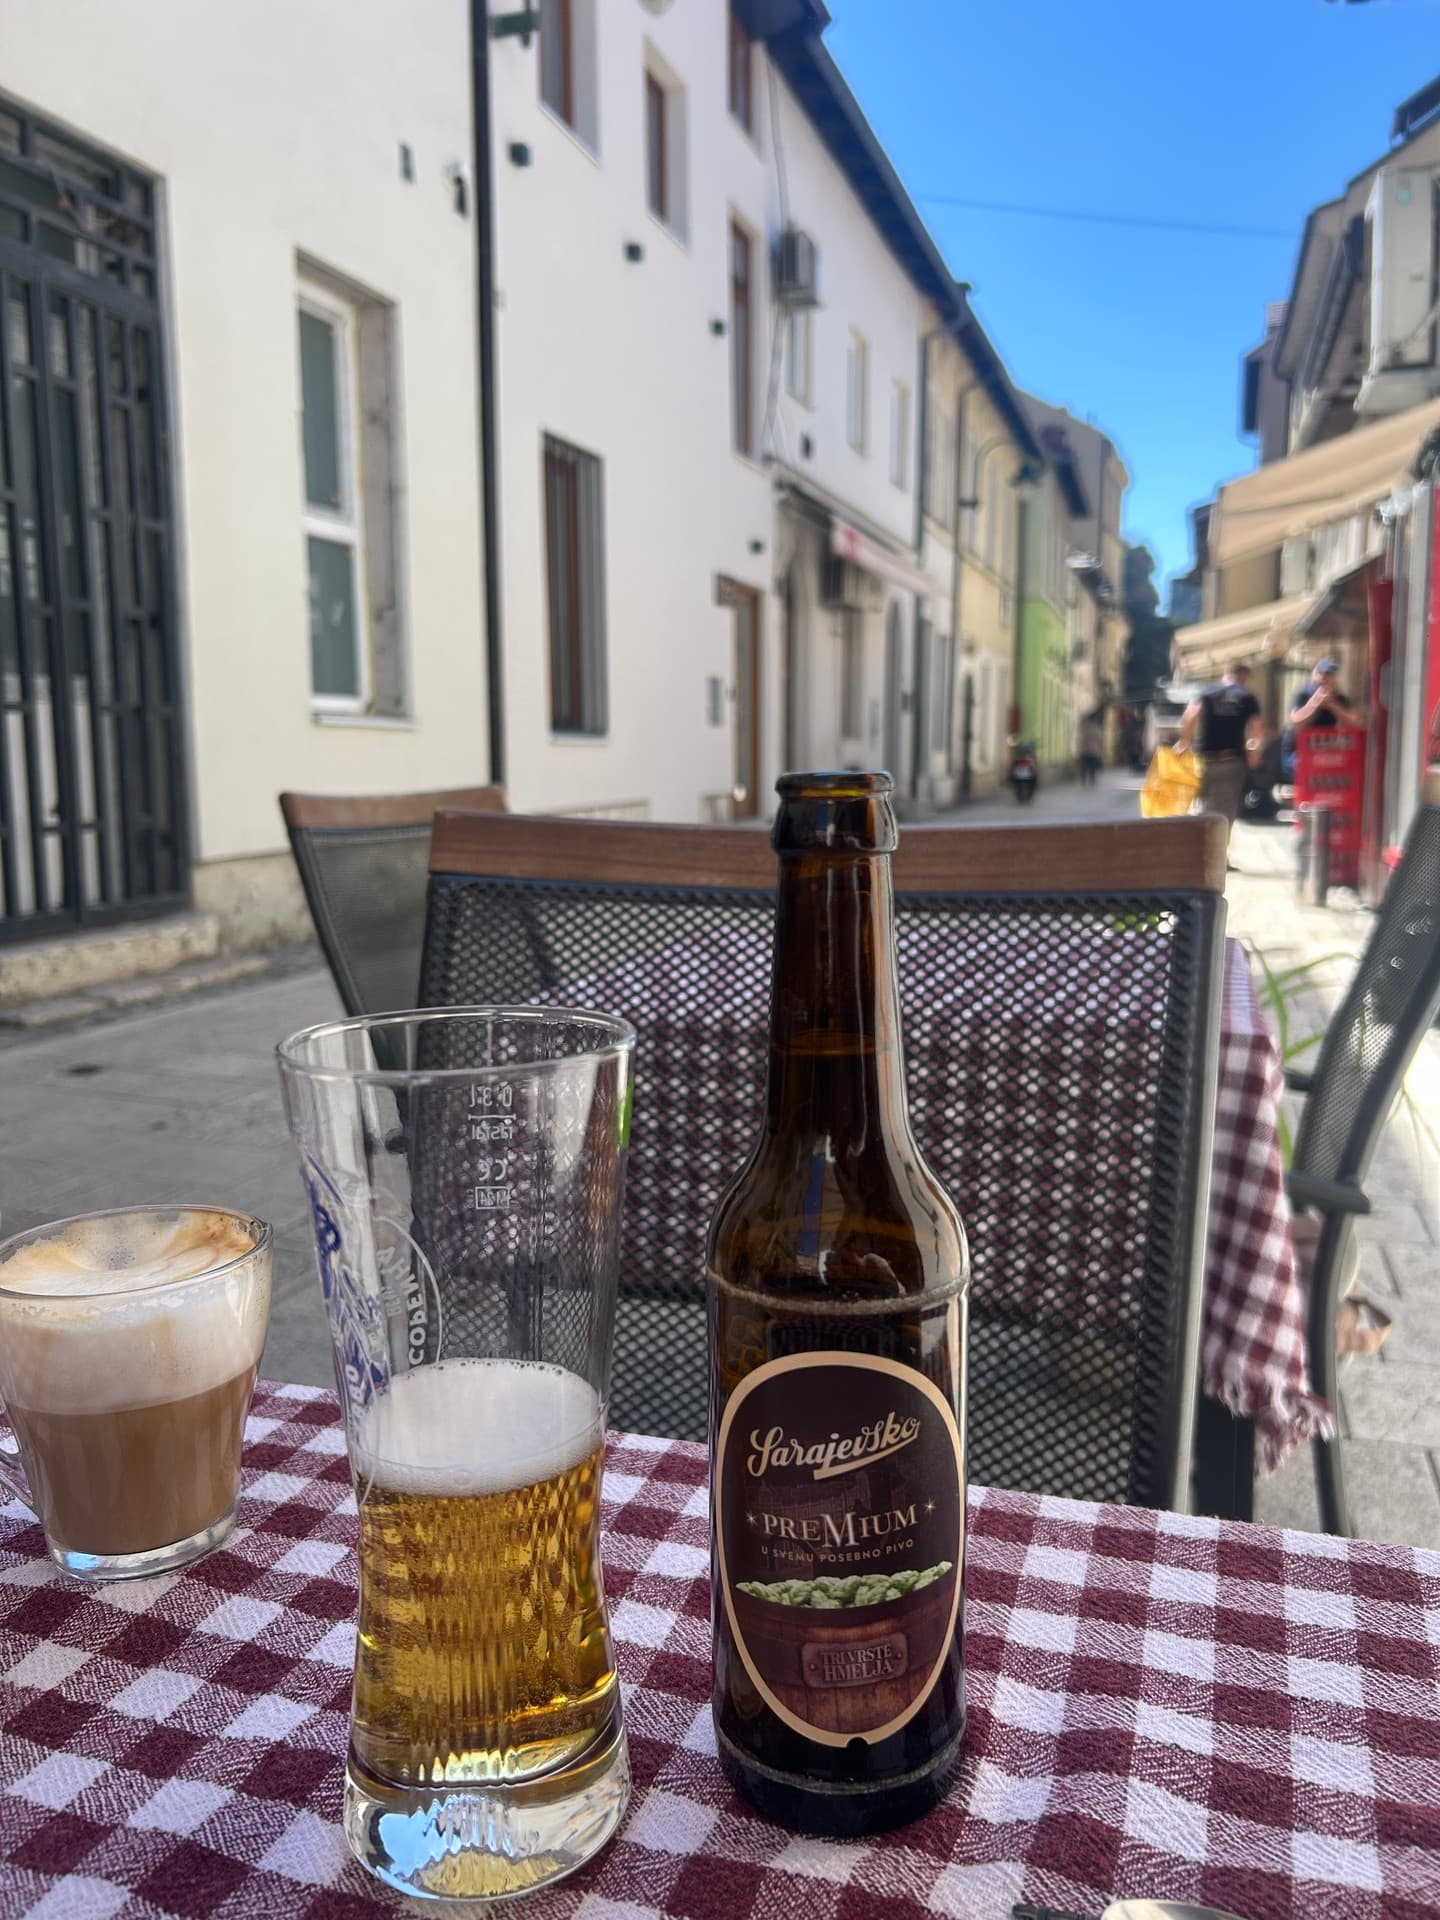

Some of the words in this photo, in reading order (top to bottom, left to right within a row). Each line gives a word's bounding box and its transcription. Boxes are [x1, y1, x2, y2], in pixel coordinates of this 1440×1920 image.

[746, 1410, 921, 1481] Sarajevsko
[761, 1503, 919, 1549] PREMIUM
[761, 1545, 769, 1555] U
[772, 1549, 815, 1563] SVEMU
[819, 1548, 882, 1563] POSEBNO
[885, 1538, 914, 1555] PIVO
[846, 1644, 892, 1663] VRSTE
[823, 1659, 894, 1681] HMELJA
